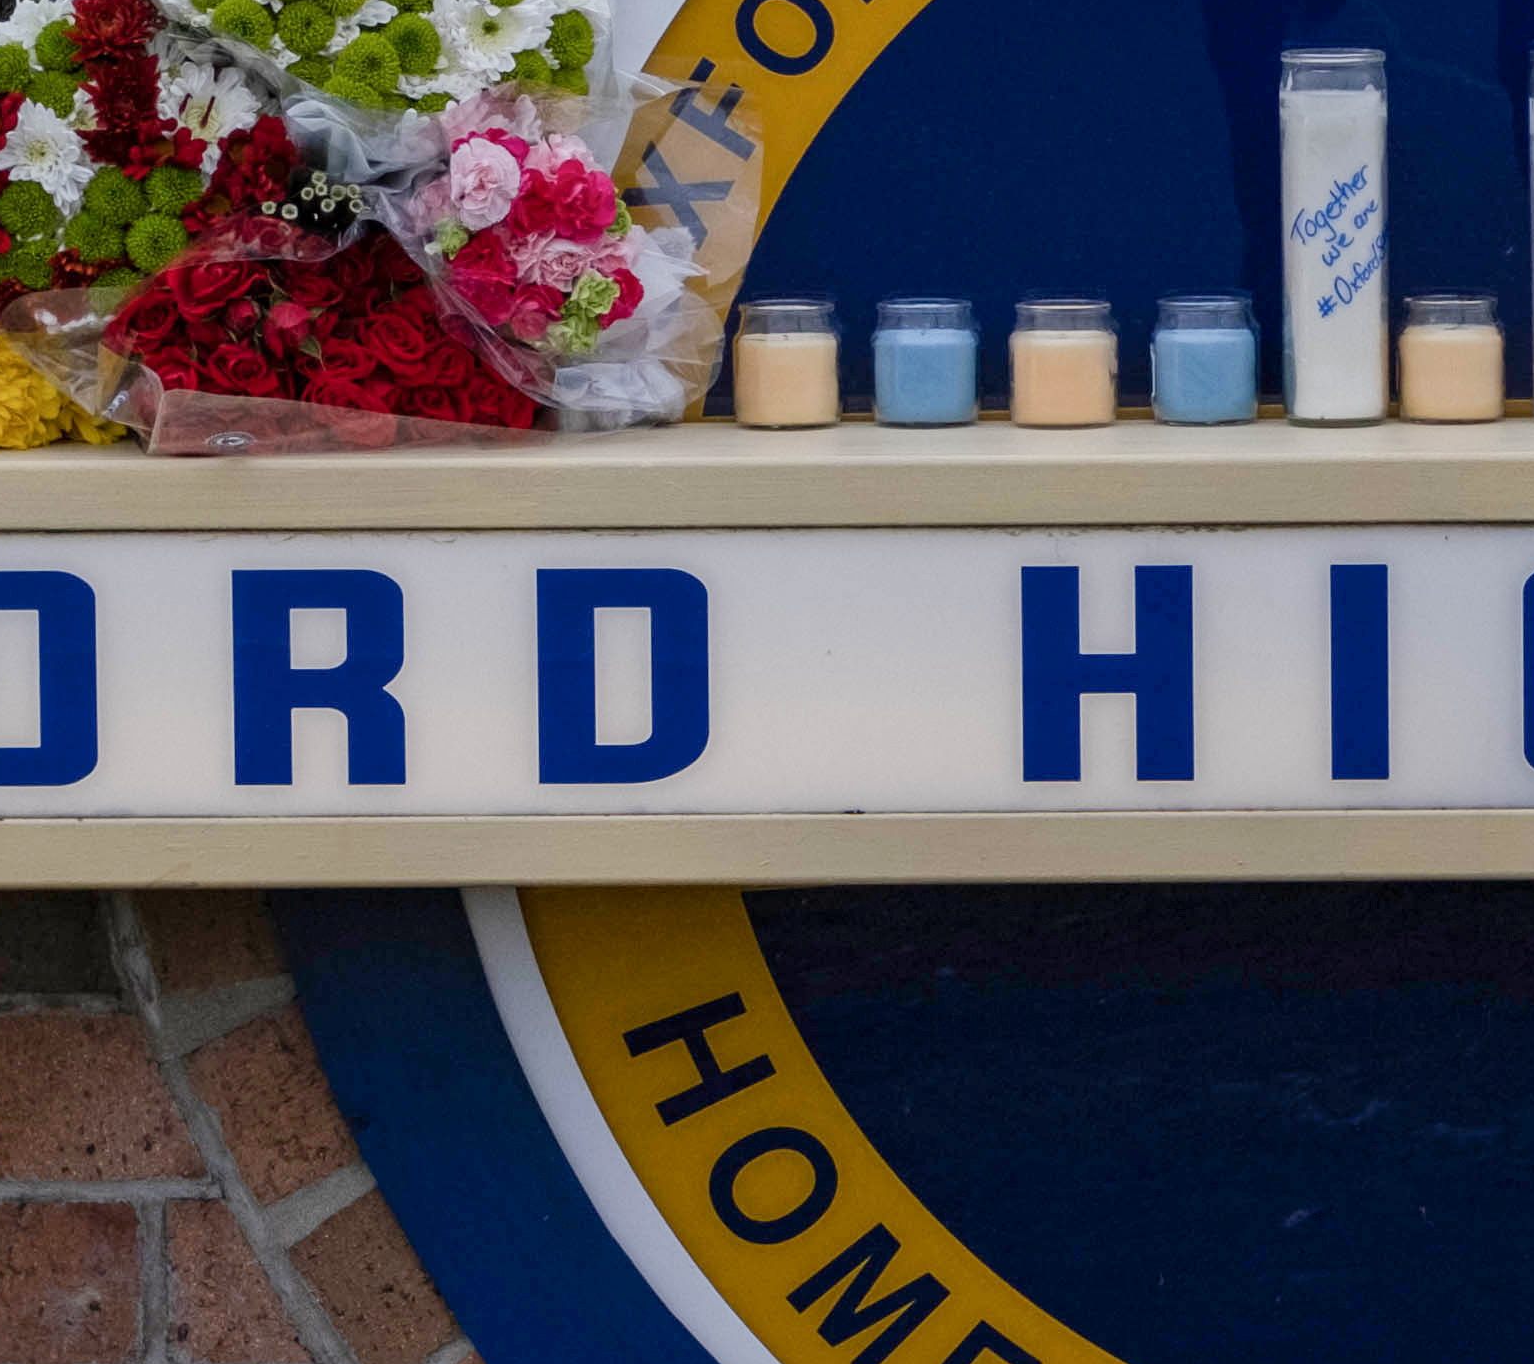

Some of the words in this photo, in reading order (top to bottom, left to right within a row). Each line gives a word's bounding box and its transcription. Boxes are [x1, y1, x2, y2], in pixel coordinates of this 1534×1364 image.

[1290, 165, 1368, 245] Together
[1322, 233, 1354, 267] we
[1354, 199, 1378, 229] are
